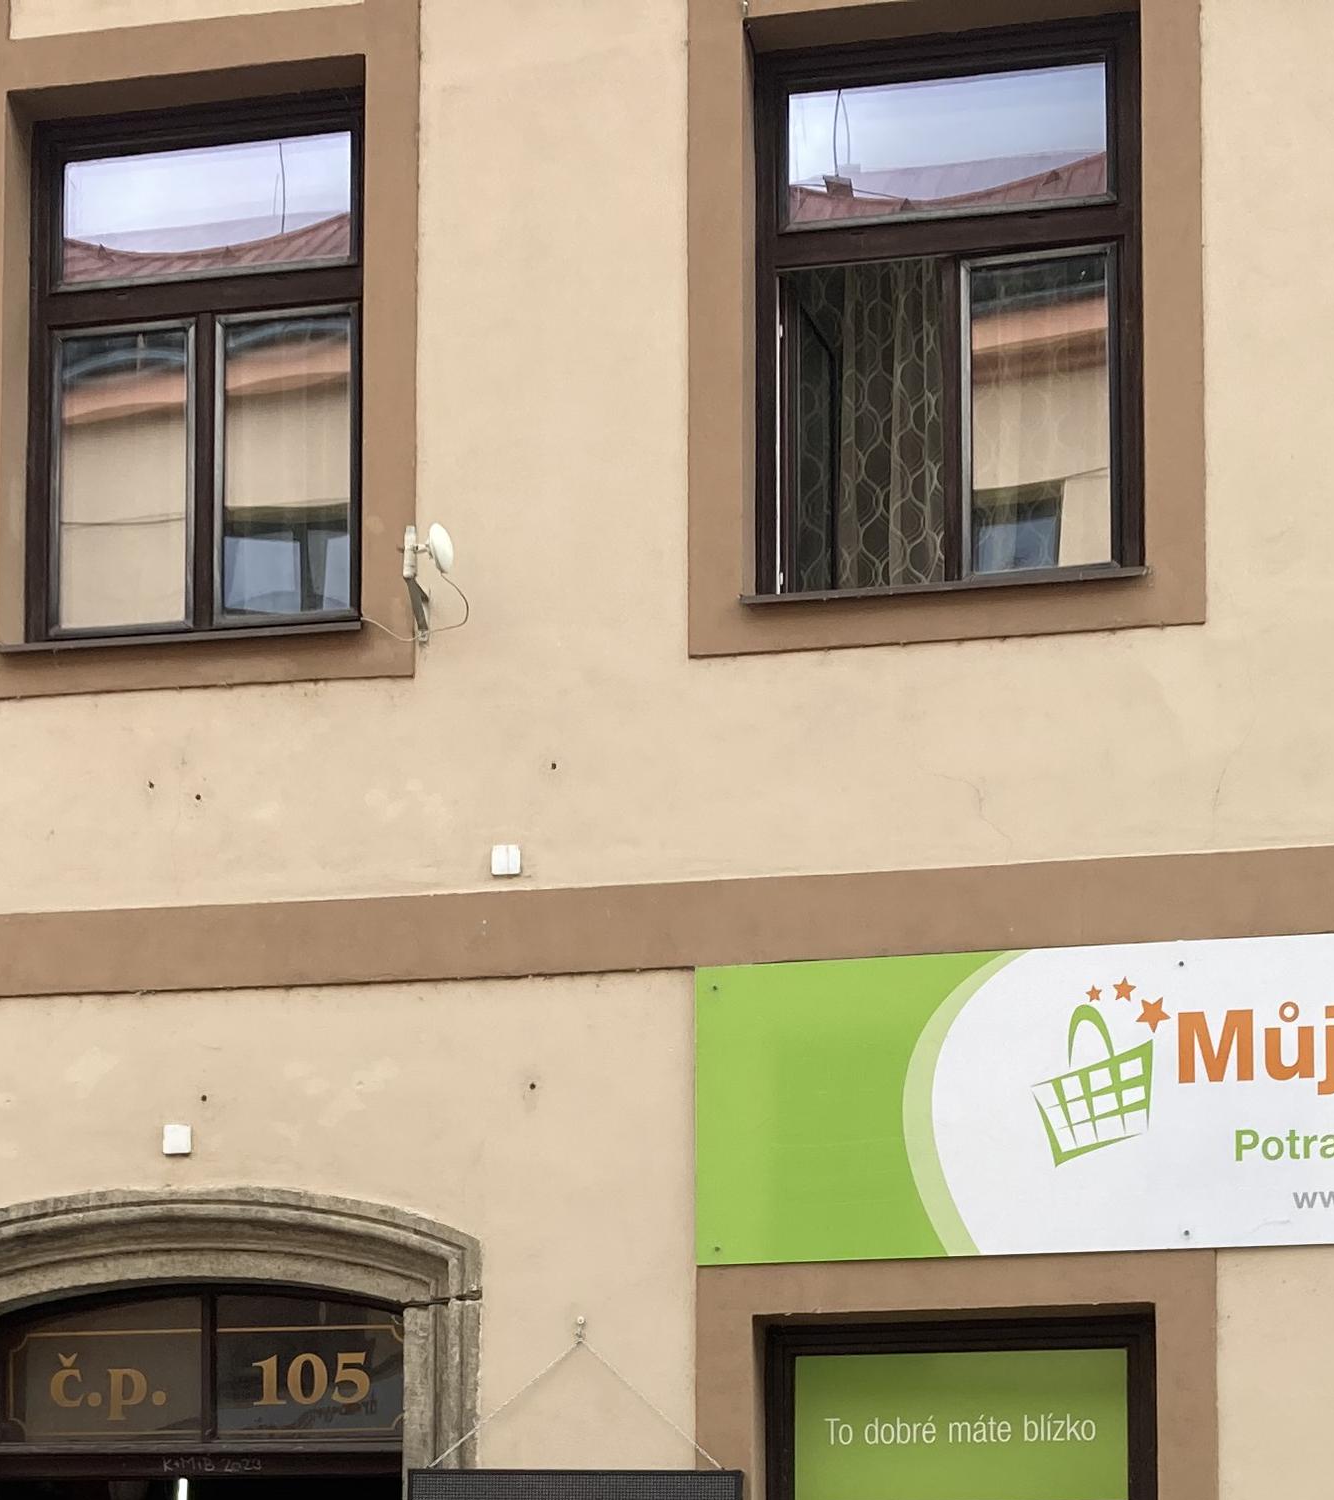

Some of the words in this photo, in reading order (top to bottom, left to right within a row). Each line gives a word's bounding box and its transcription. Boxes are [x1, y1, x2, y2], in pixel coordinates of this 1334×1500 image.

[49, 1352, 167, 1421] č.p.
[251, 1351, 371, 1406] 105
[824, 1417, 853, 1446] To
[864, 1414, 937, 1446] dobré
[948, 1413, 1012, 1444] máte
[1023, 1412, 1097, 1443] blízko
